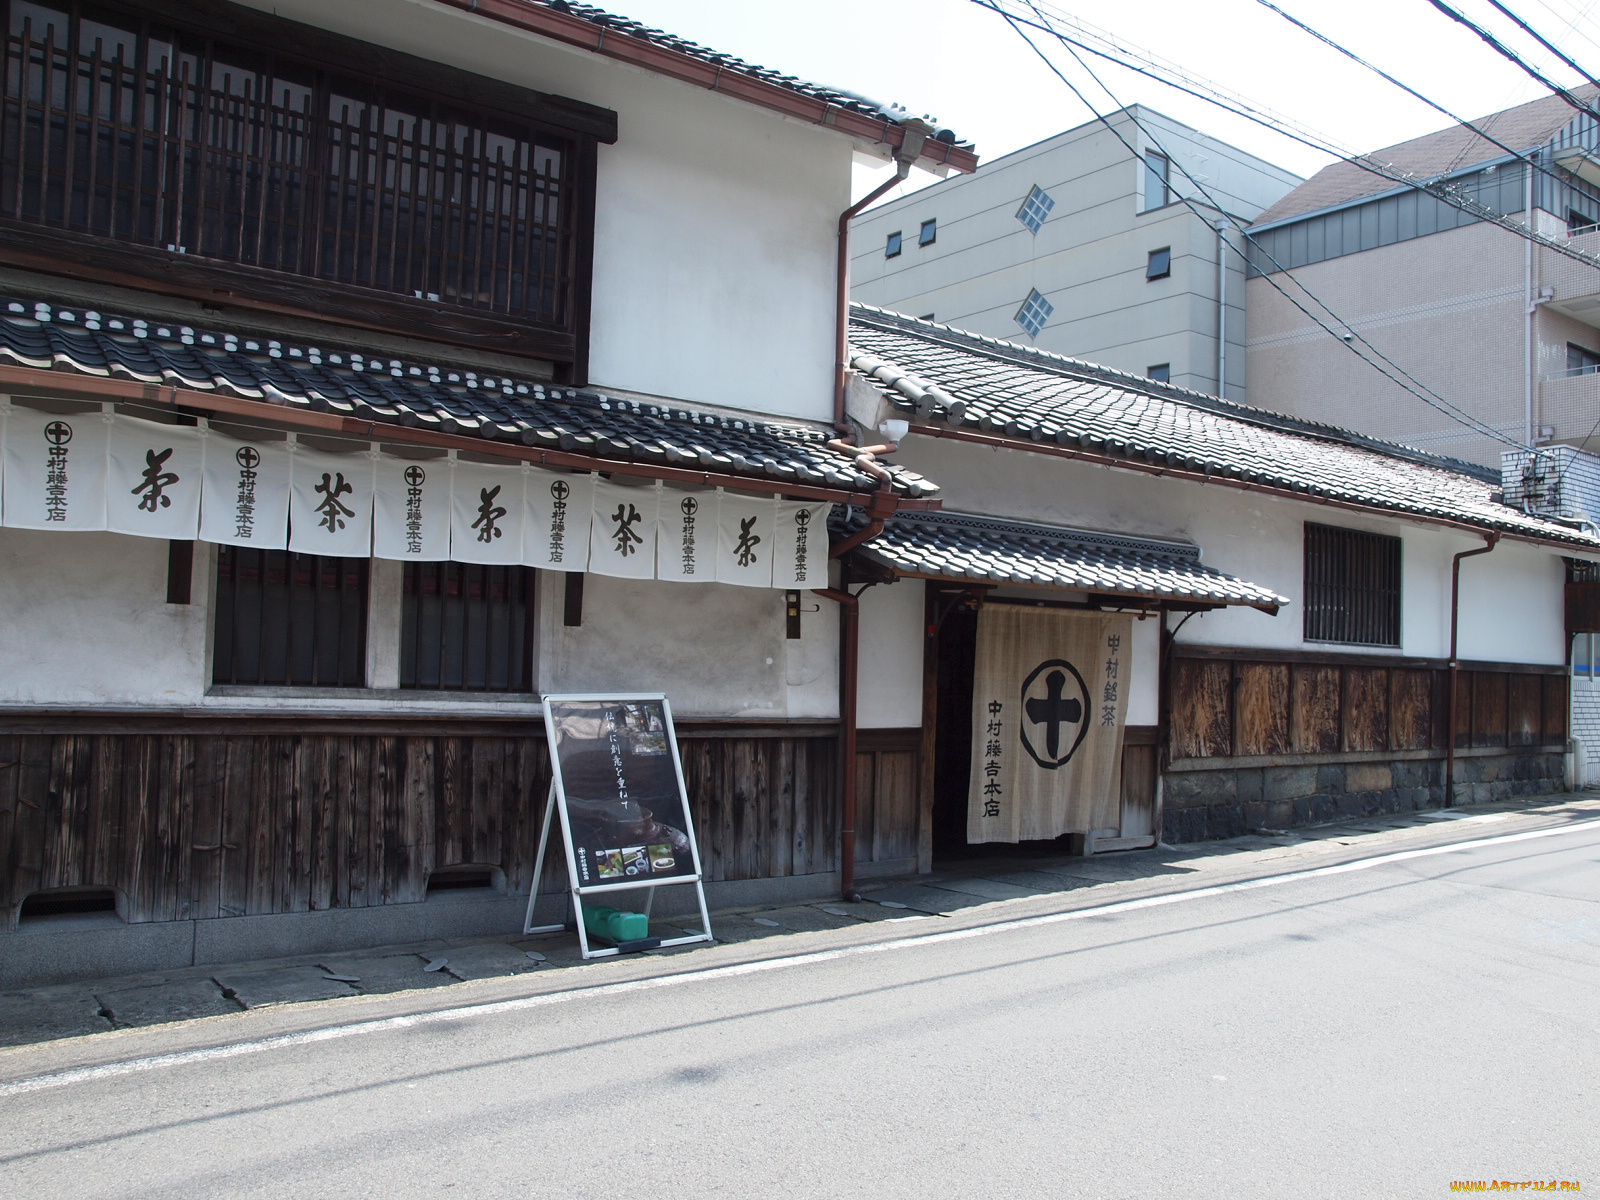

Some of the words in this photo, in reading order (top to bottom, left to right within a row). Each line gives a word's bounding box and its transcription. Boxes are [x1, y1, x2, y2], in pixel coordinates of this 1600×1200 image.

[131, 448, 180, 512] 茶
[314, 472, 355, 533] 茶
[471, 485, 507, 543] 茶
[611, 503, 643, 557] 茶
[733, 516, 761, 567] 茶
